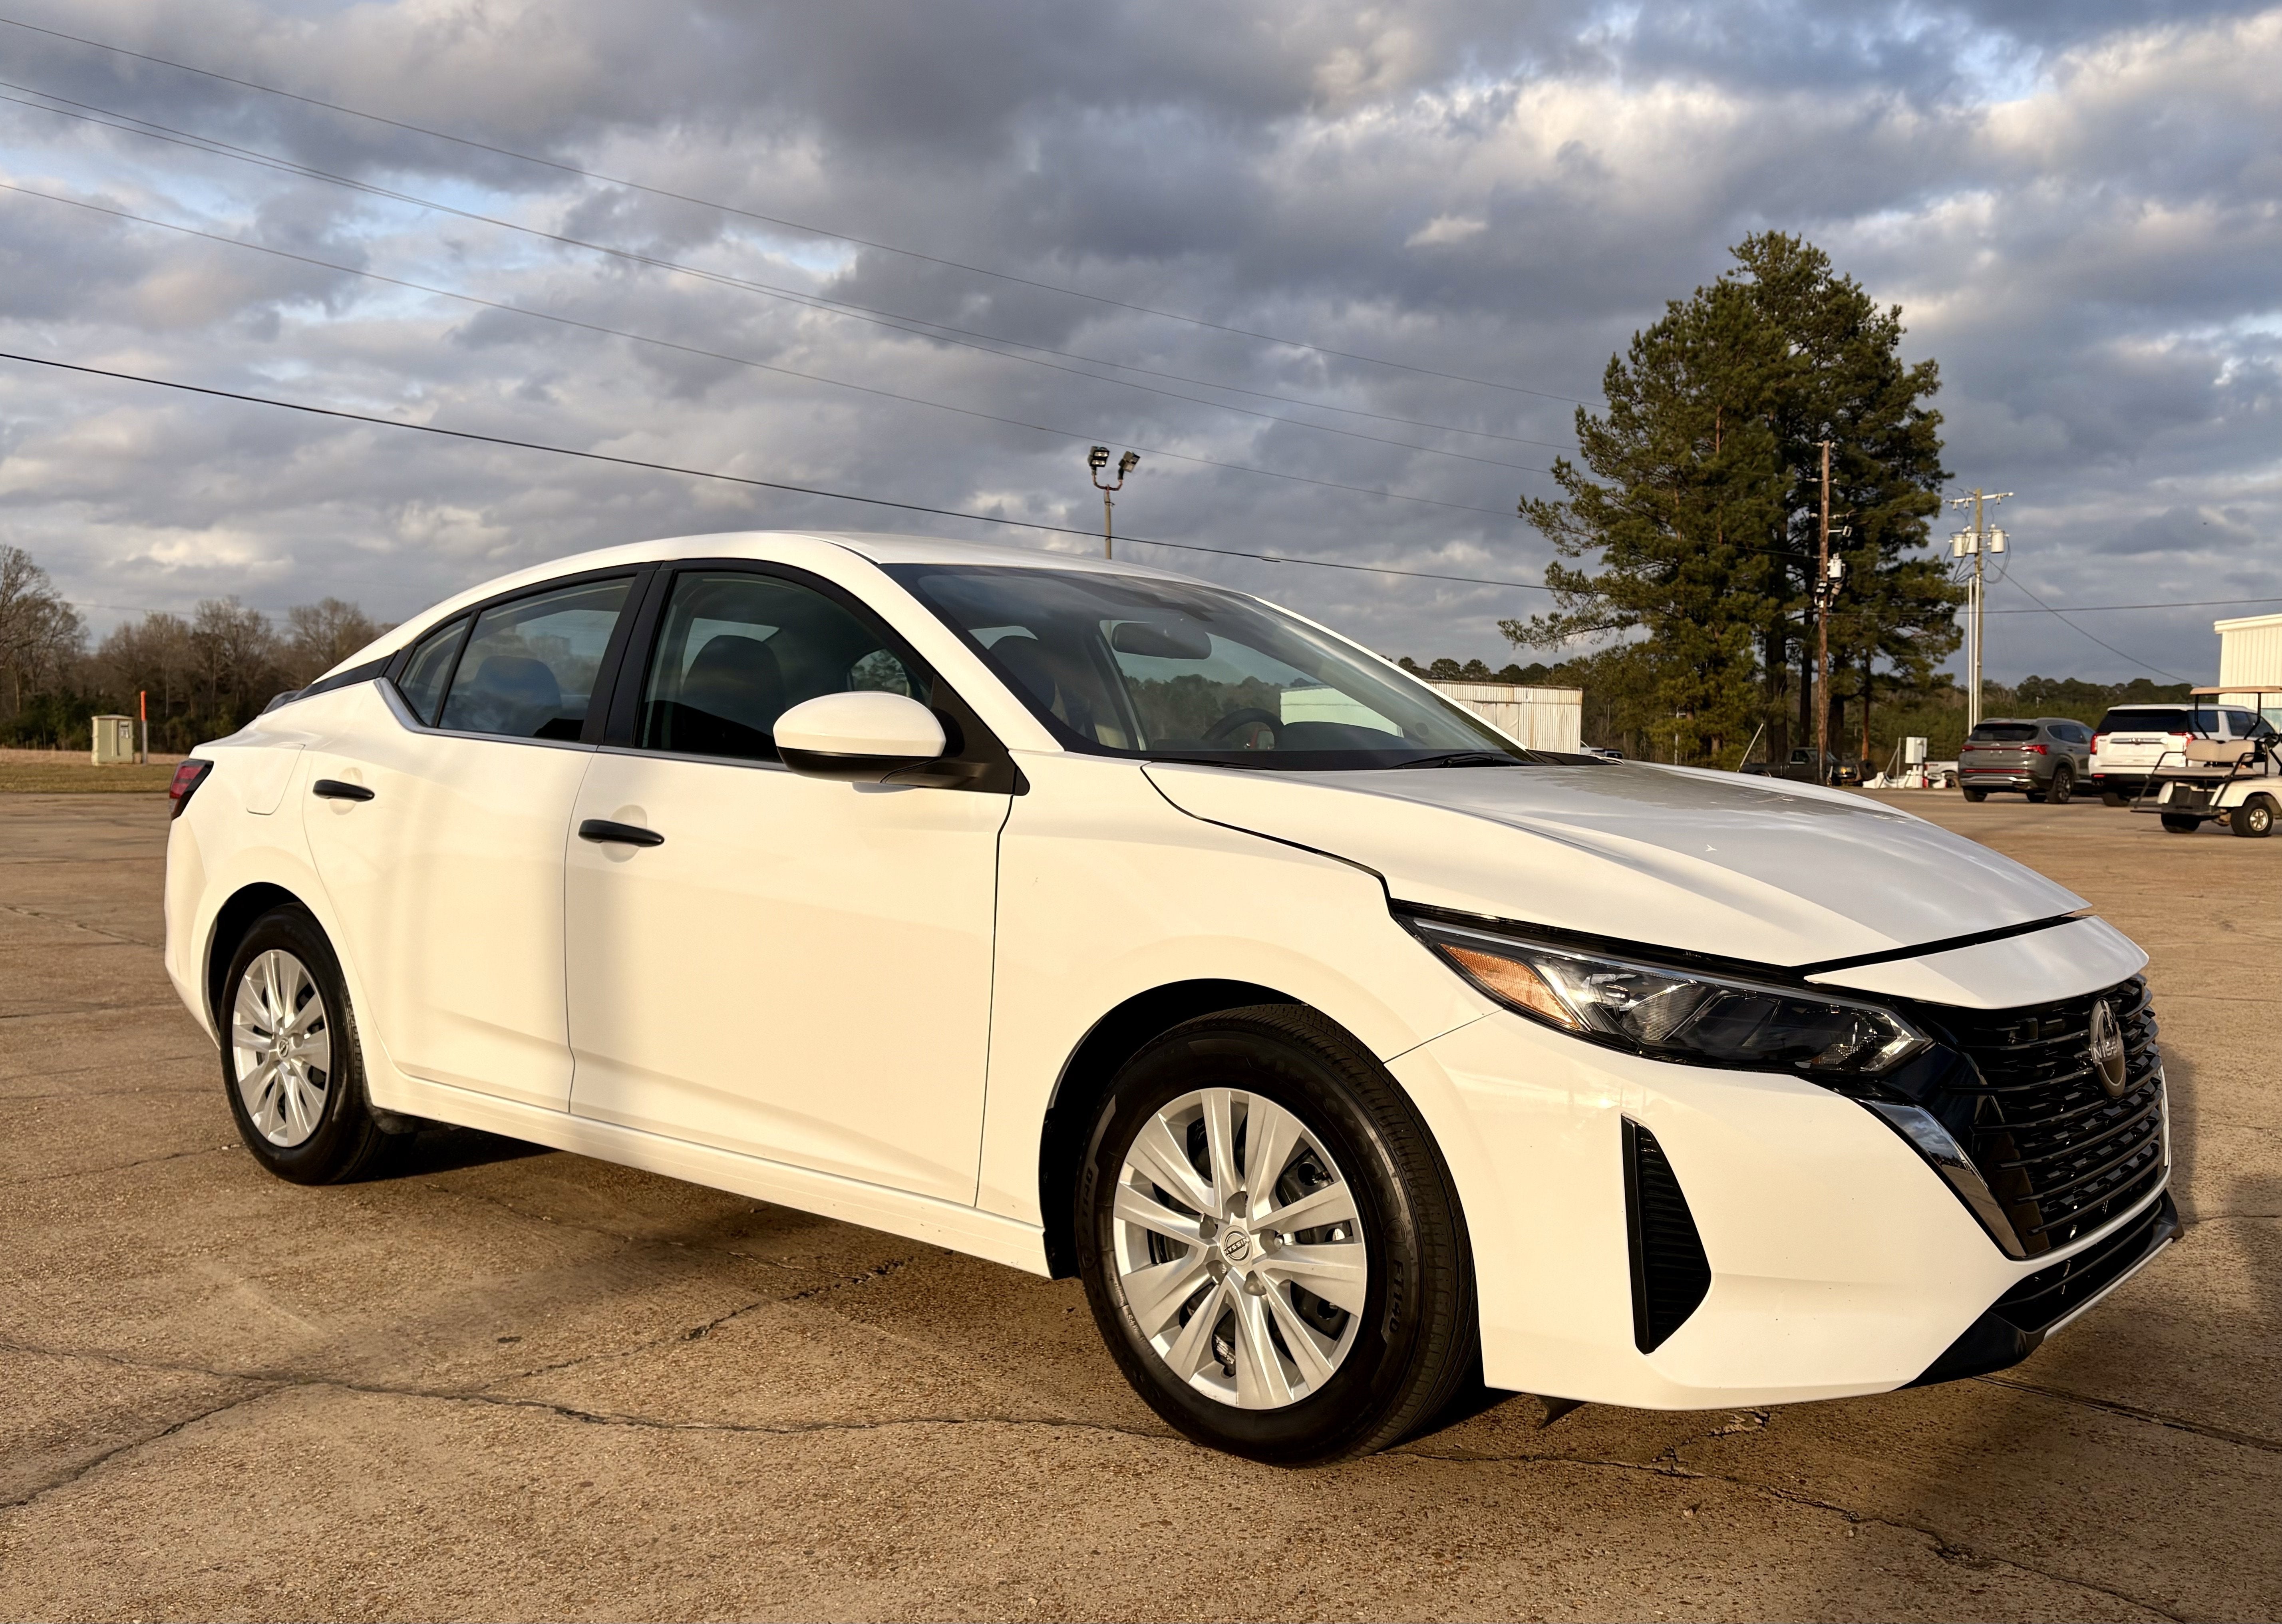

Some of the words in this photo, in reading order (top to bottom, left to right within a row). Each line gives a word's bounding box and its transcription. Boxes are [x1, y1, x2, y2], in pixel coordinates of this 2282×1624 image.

[2093, 1040, 2122, 1059] NISS
[1224, 1237, 1249, 1255] NISSAN
[1389, 1259, 1403, 1333] FT140
